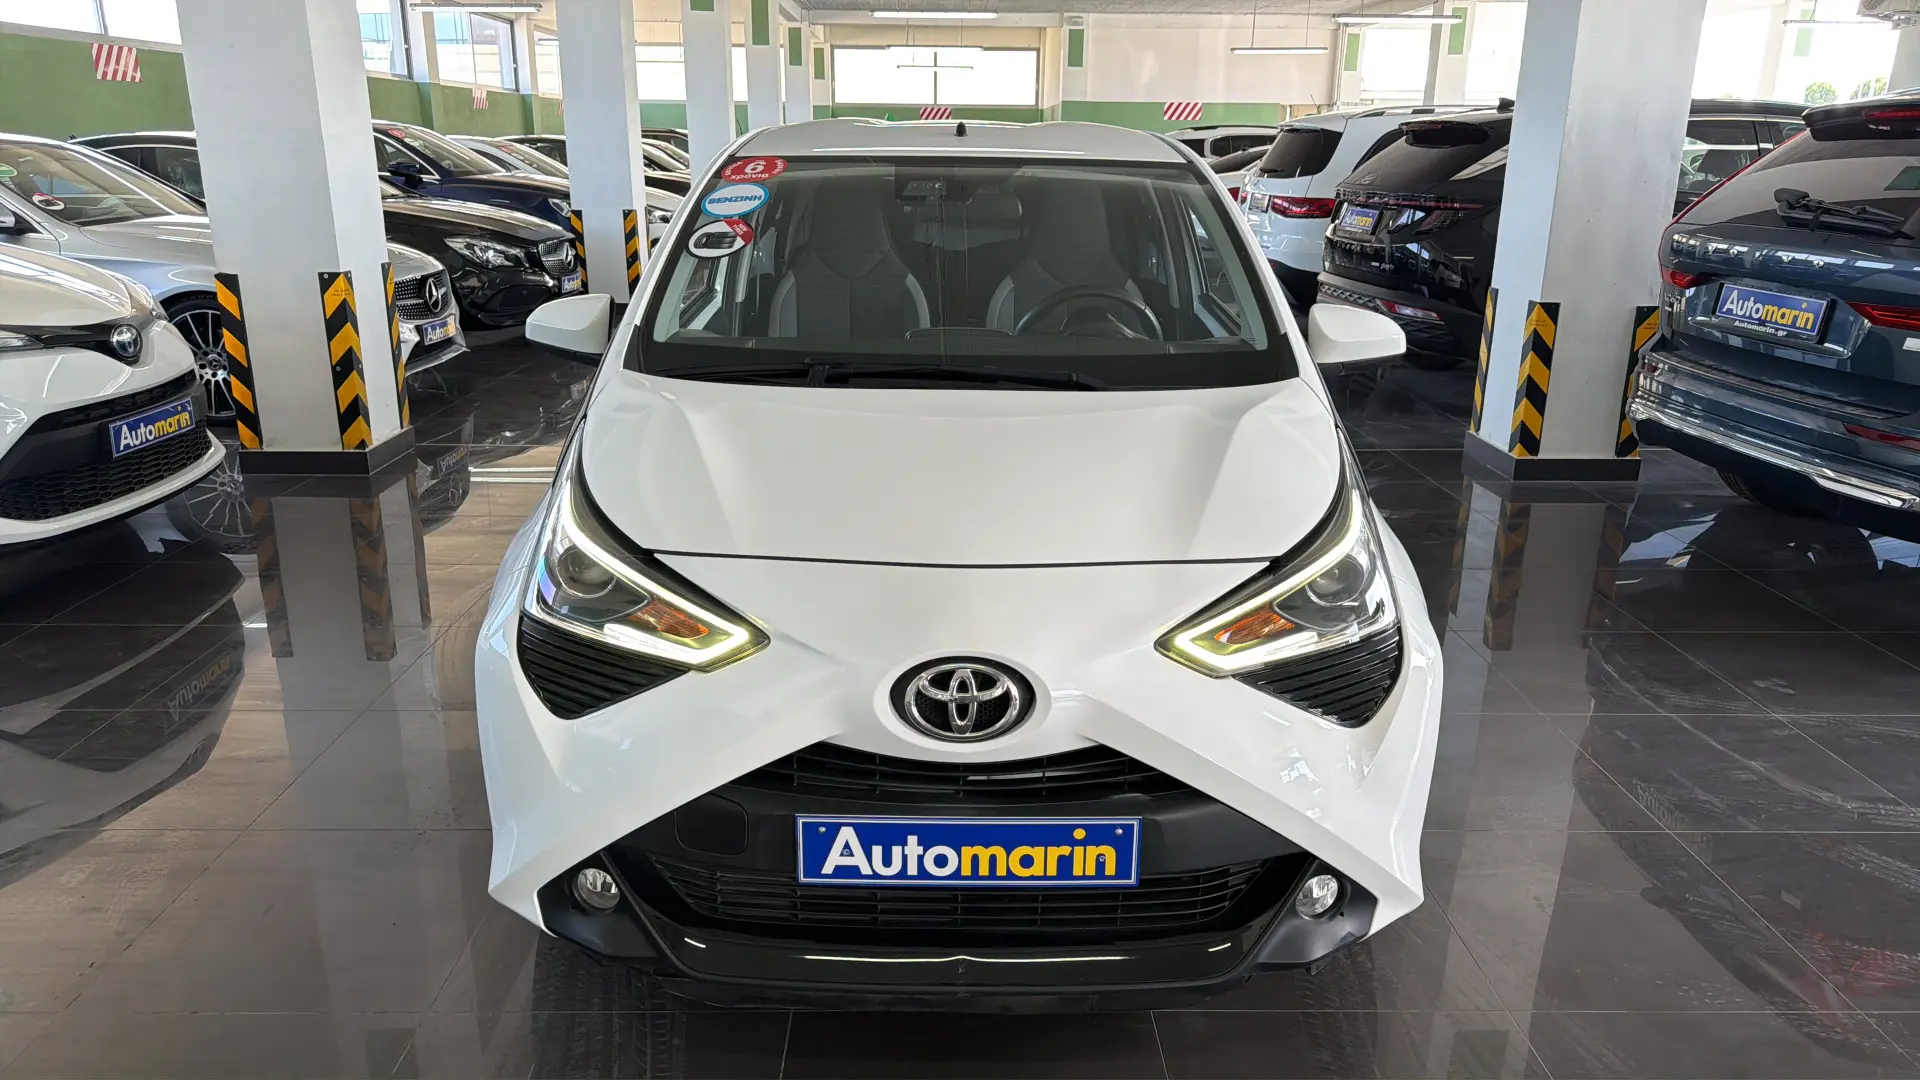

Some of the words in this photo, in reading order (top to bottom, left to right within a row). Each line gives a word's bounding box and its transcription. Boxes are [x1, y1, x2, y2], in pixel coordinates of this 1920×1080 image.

[744, 161, 766, 174] 6
[1722, 289, 1815, 330] Automarin
[1733, 320, 1788, 337] Automarin.gr
[119, 405, 191, 451] Automarin
[820, 826, 1117, 877] Automarin
